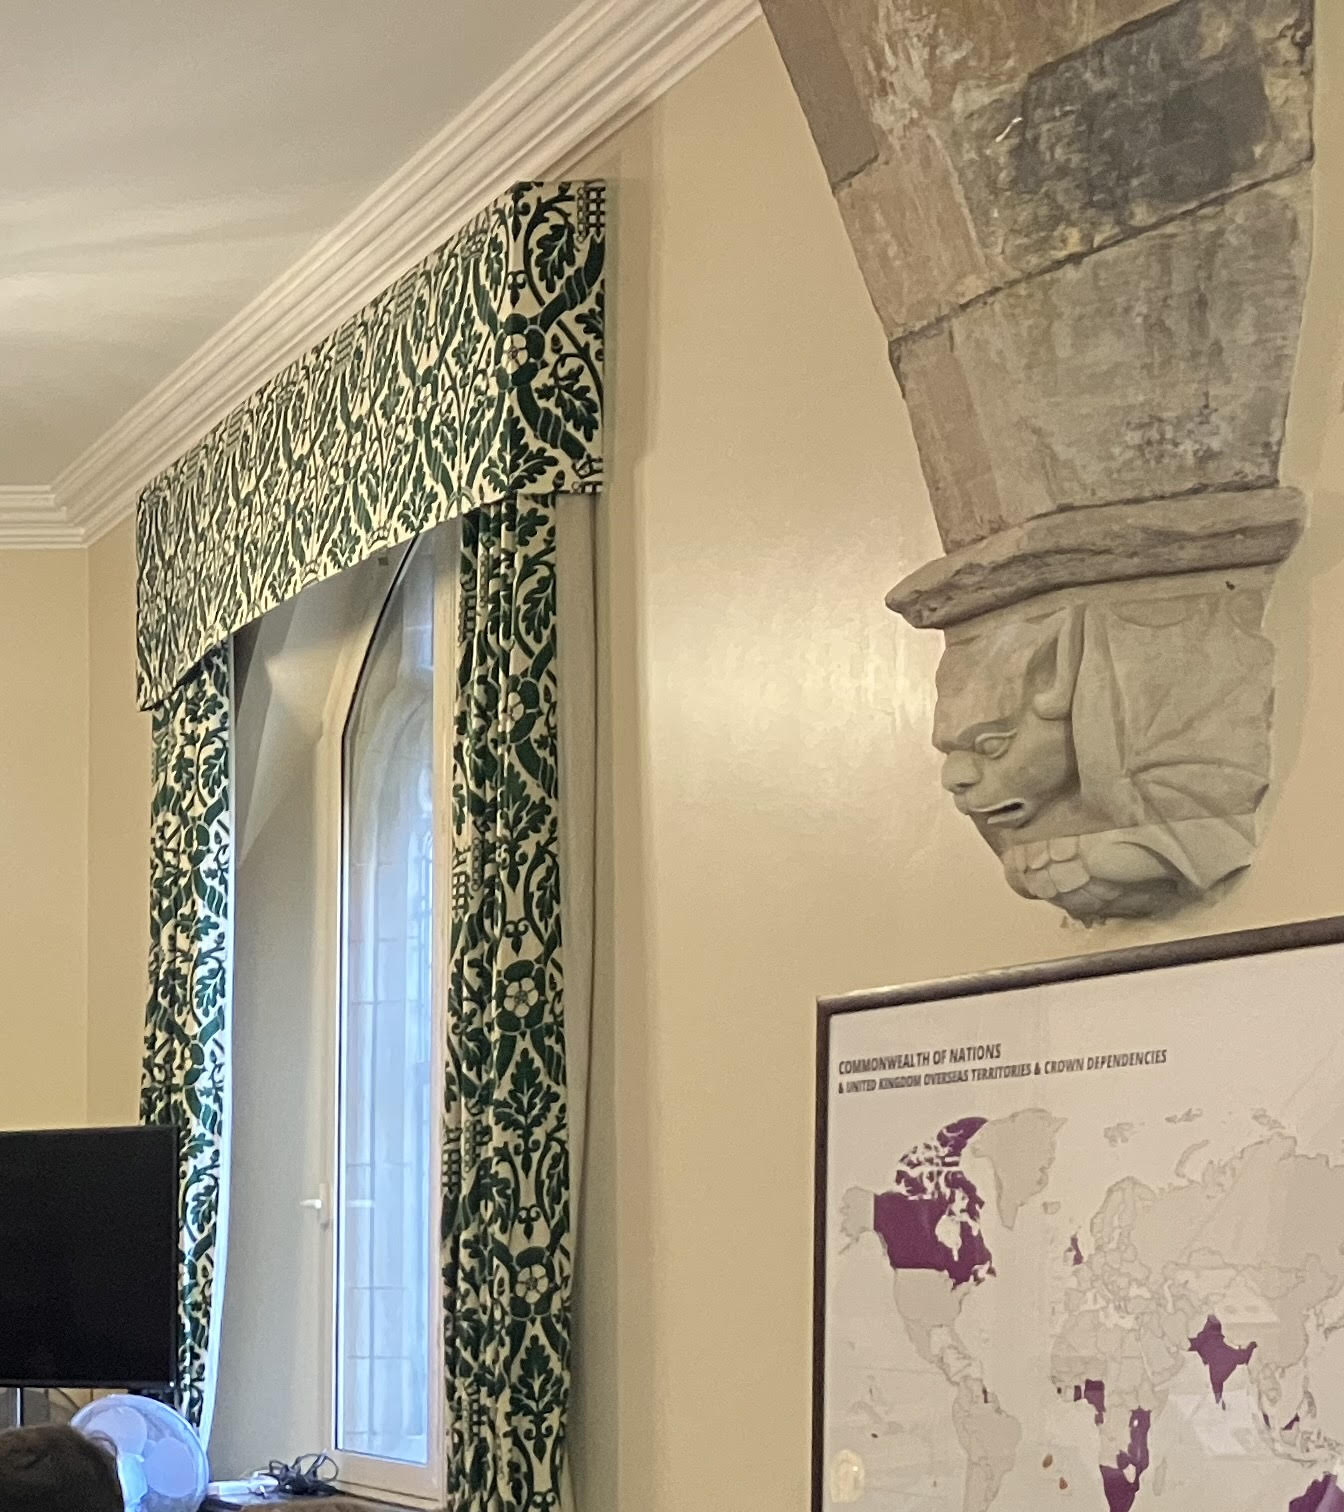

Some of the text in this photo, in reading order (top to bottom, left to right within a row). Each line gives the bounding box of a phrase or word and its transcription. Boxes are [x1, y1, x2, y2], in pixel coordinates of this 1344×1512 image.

[838, 1043, 1001, 1075] COMMONWEALTH OF NATIONS
[838, 1049, 1168, 1094] & UNITED KINGDOM OVERSEAS TERRITORIES & CROWN DEPENDENCIES
